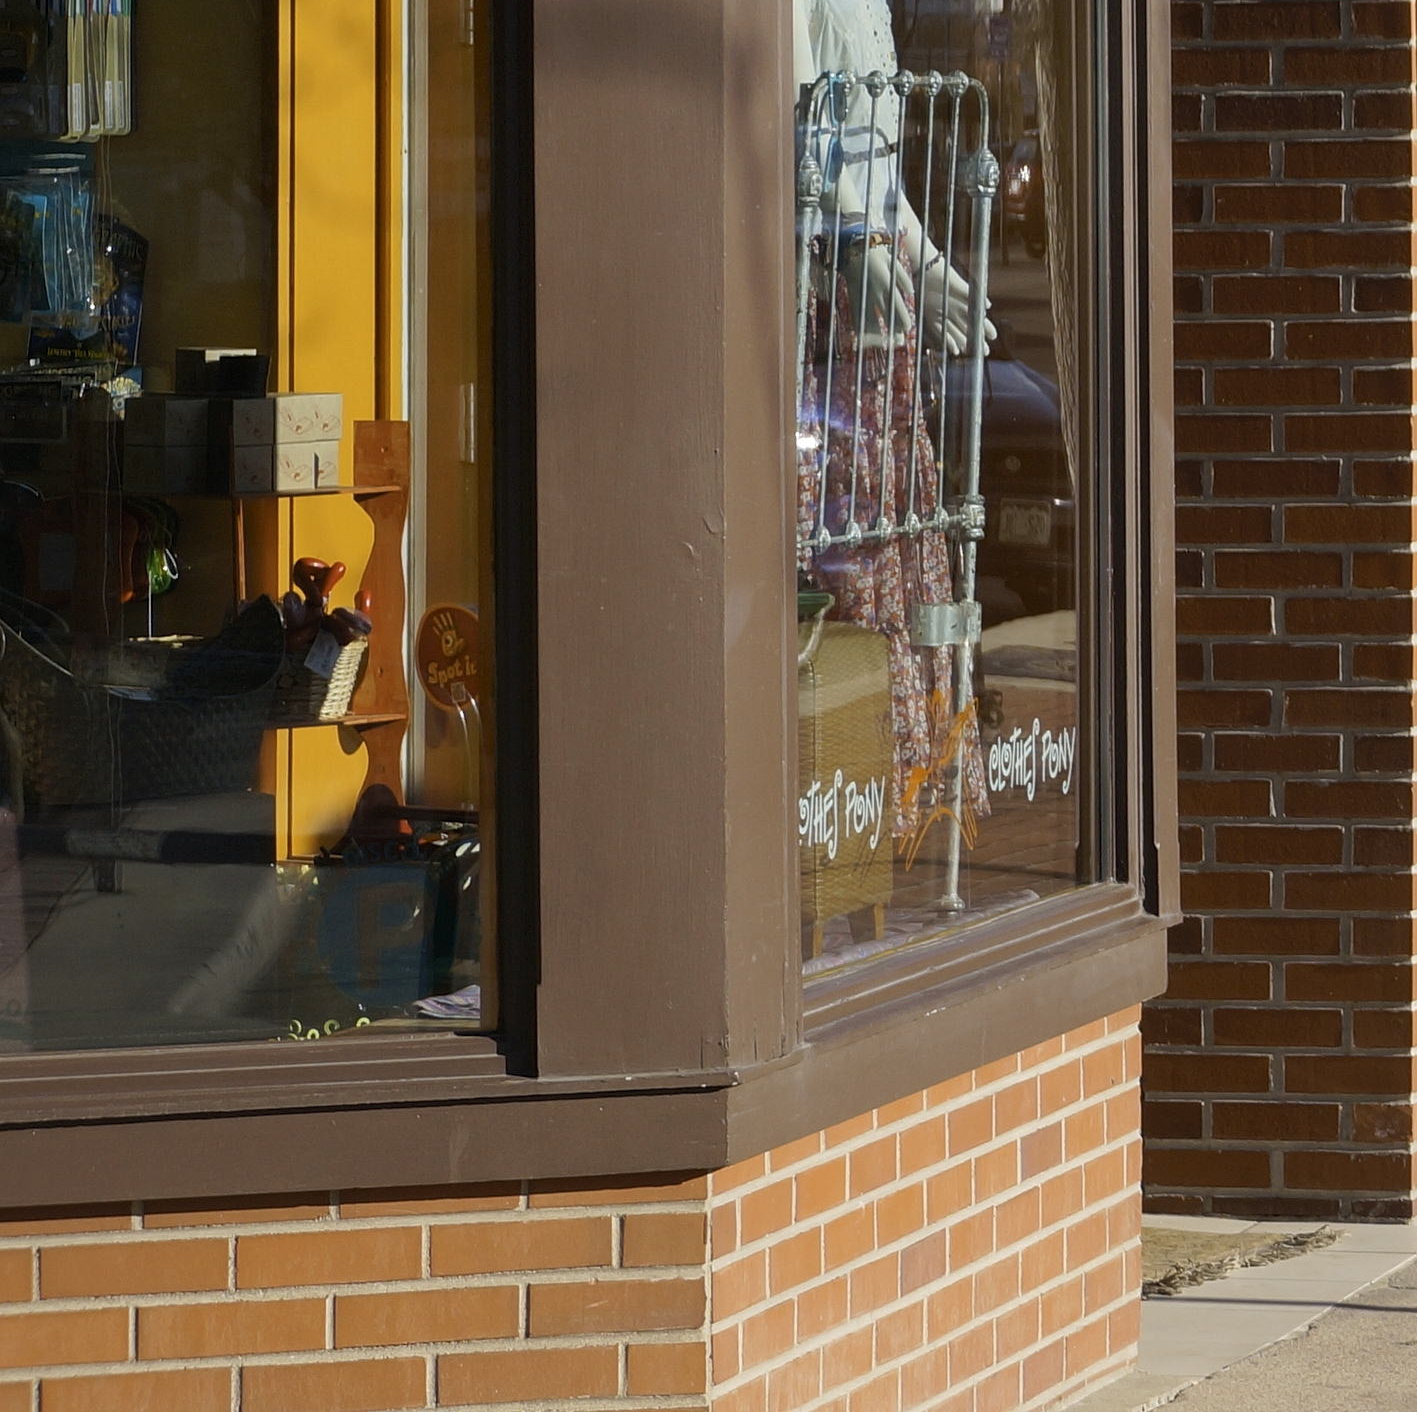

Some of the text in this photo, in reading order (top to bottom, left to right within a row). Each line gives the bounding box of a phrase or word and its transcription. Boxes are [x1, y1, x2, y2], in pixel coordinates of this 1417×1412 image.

[428, 659, 463, 689] Spot
[988, 717, 1076, 802] CLOTHES PONY
[799, 768, 886, 861] OTHES PONY
